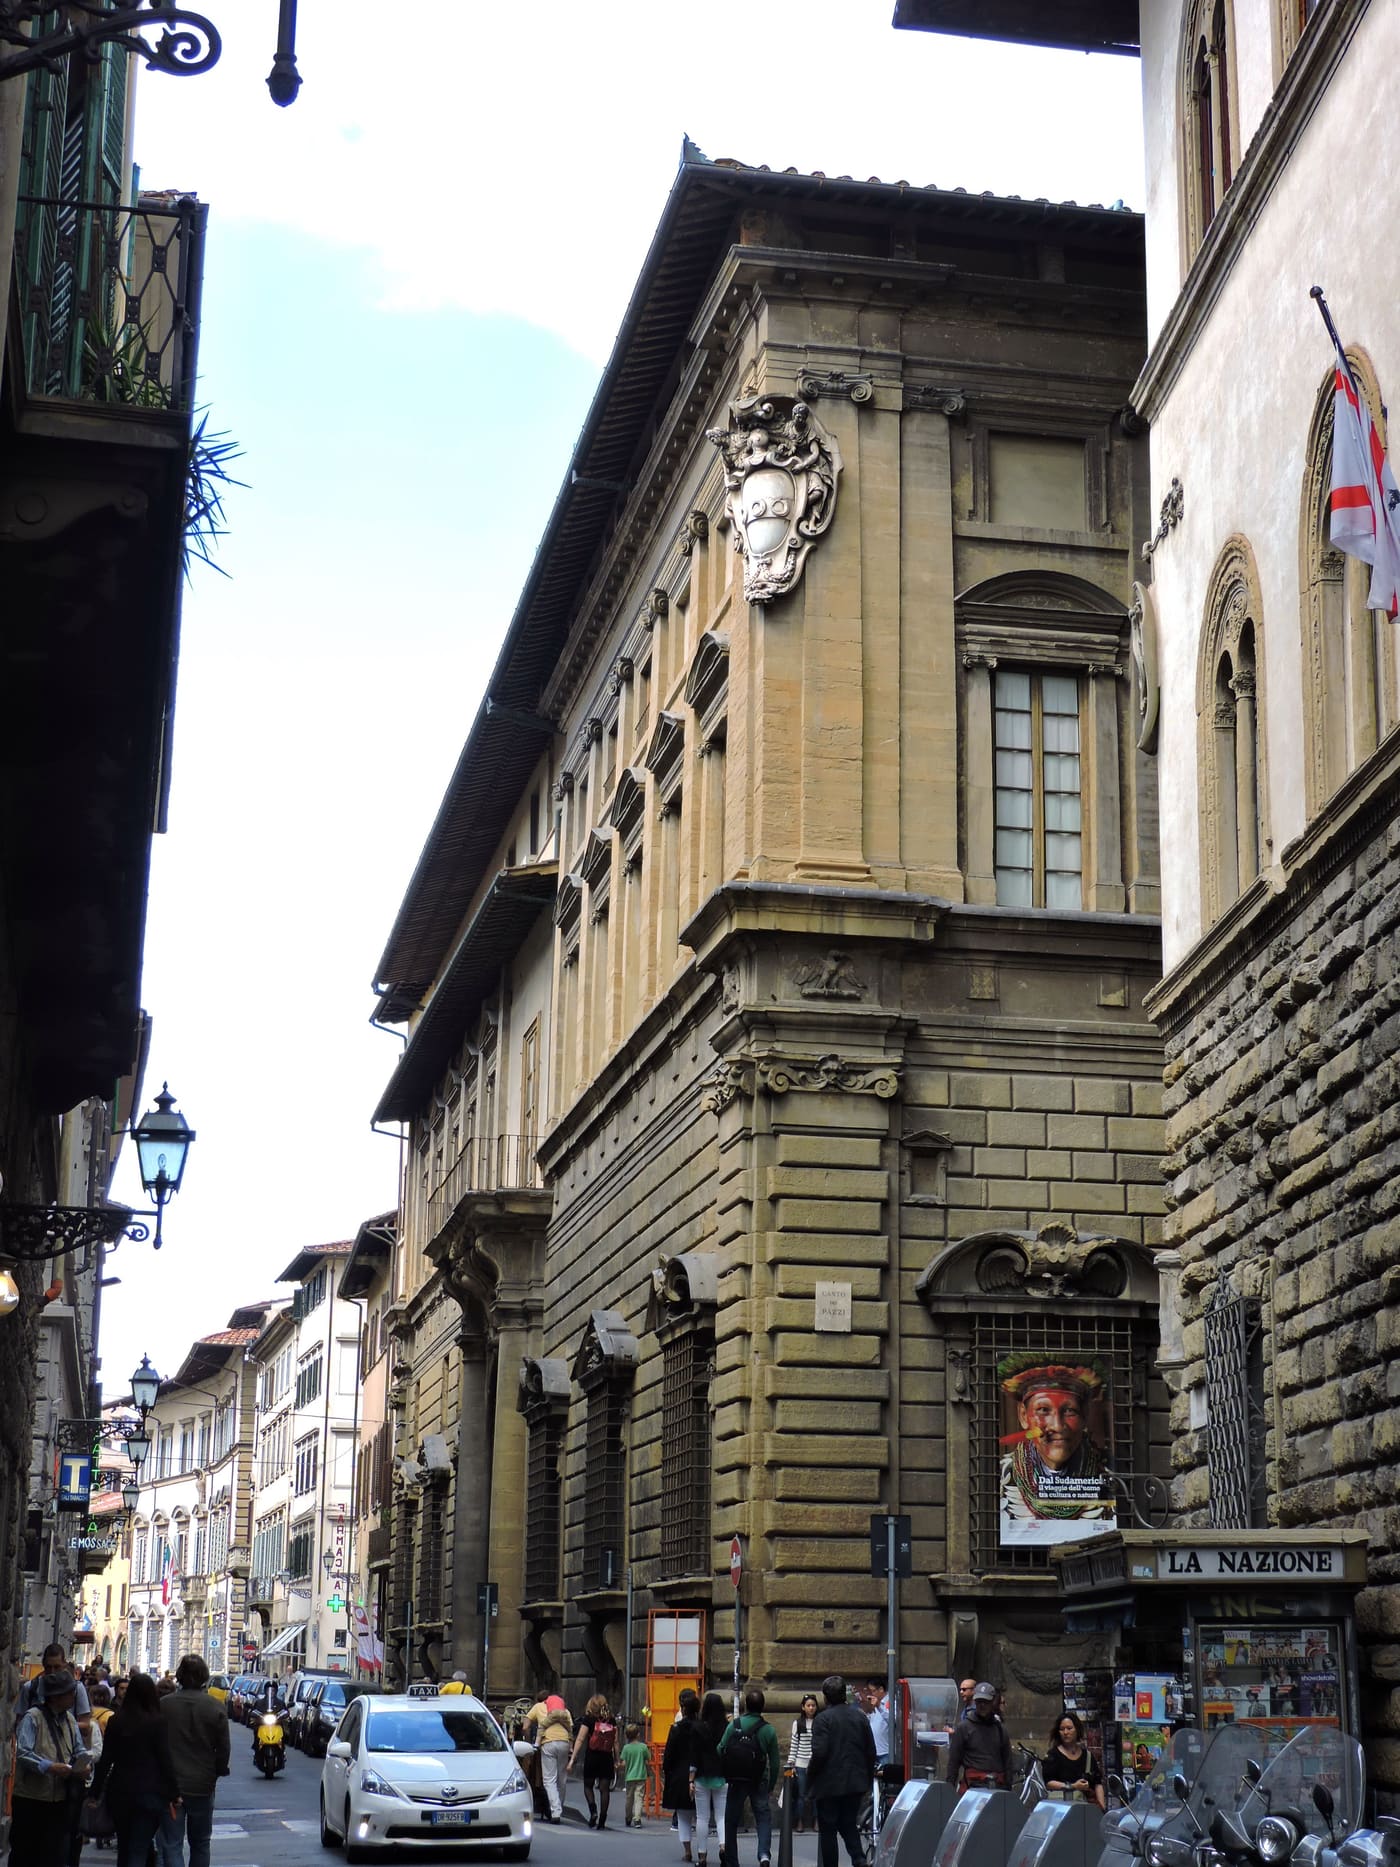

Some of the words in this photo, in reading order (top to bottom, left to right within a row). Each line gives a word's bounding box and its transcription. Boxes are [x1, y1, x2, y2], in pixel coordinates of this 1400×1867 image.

[1038, 1476, 1053, 1484] Dal
[1044, 1485, 1068, 1493] viaggio
[1168, 1551, 1203, 1574] LA
[1218, 1551, 1333, 1573] NAZIONE
[411, 1687, 437, 1695] TAXI
